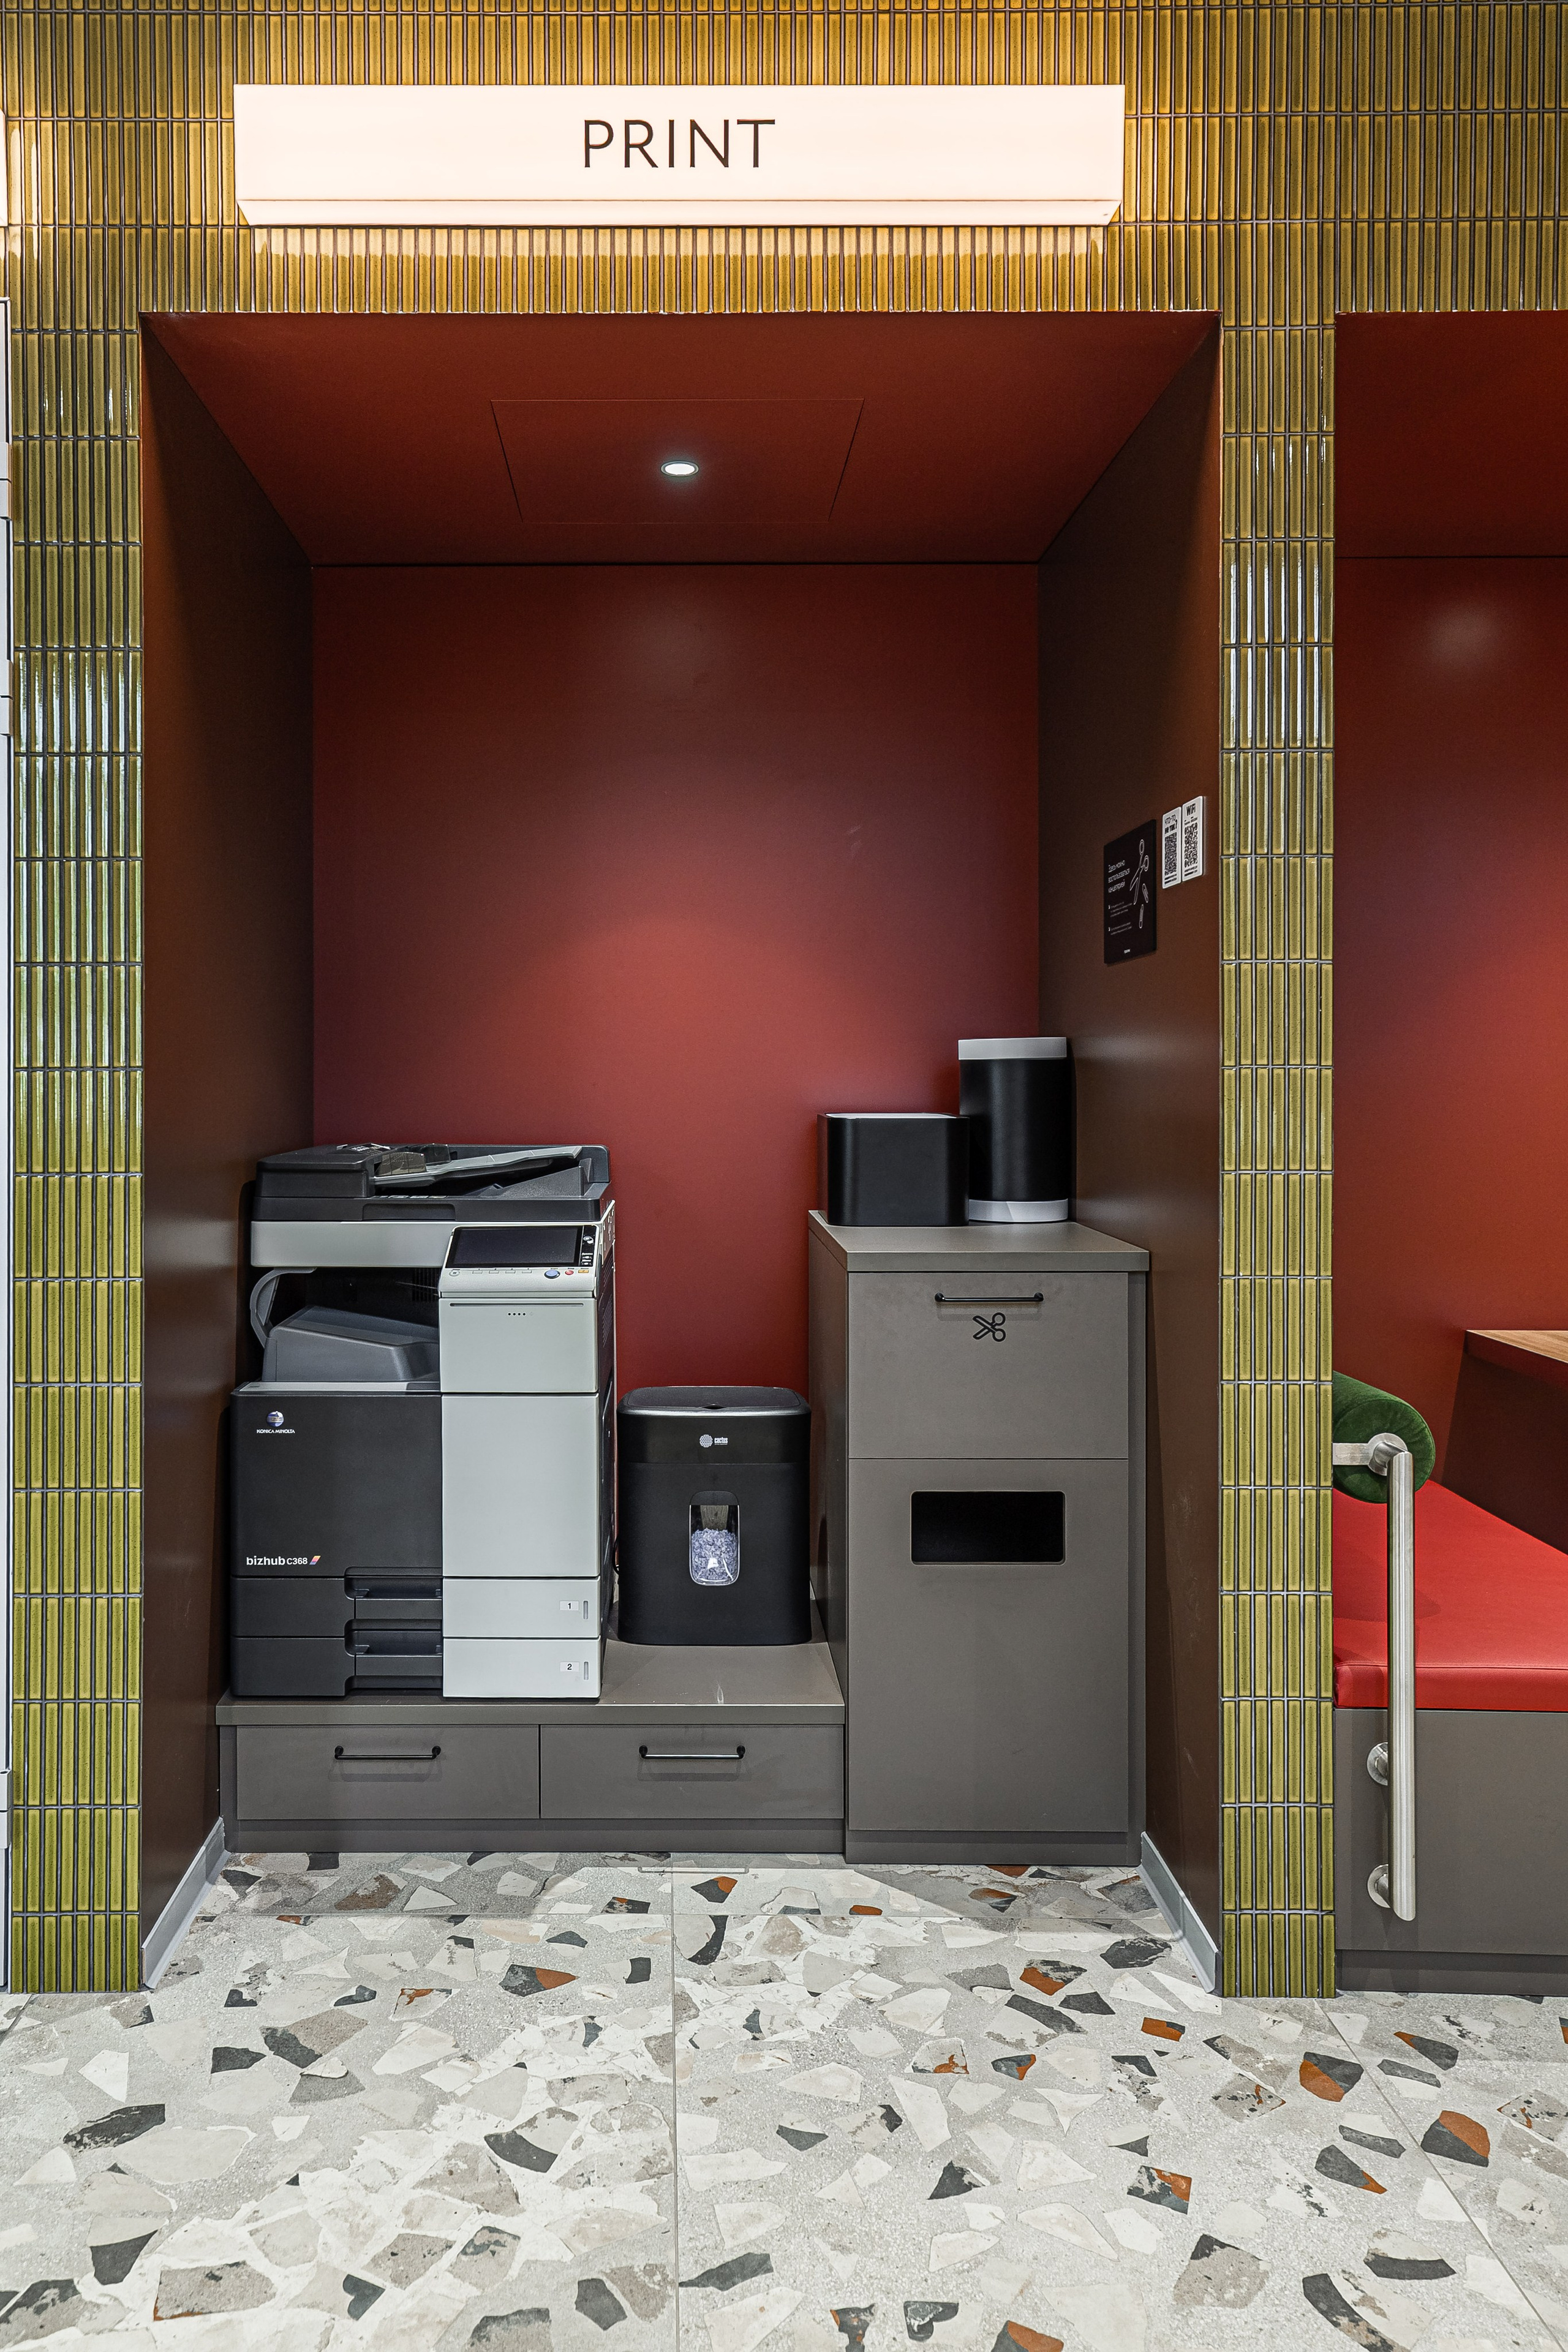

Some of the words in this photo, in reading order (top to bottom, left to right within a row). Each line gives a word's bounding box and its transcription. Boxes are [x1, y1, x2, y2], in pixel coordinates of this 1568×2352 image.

[584, 119, 775, 168] PRINT
[1186, 803, 1196, 816] WiFi
[246, 1555, 285, 1566] bizhub
